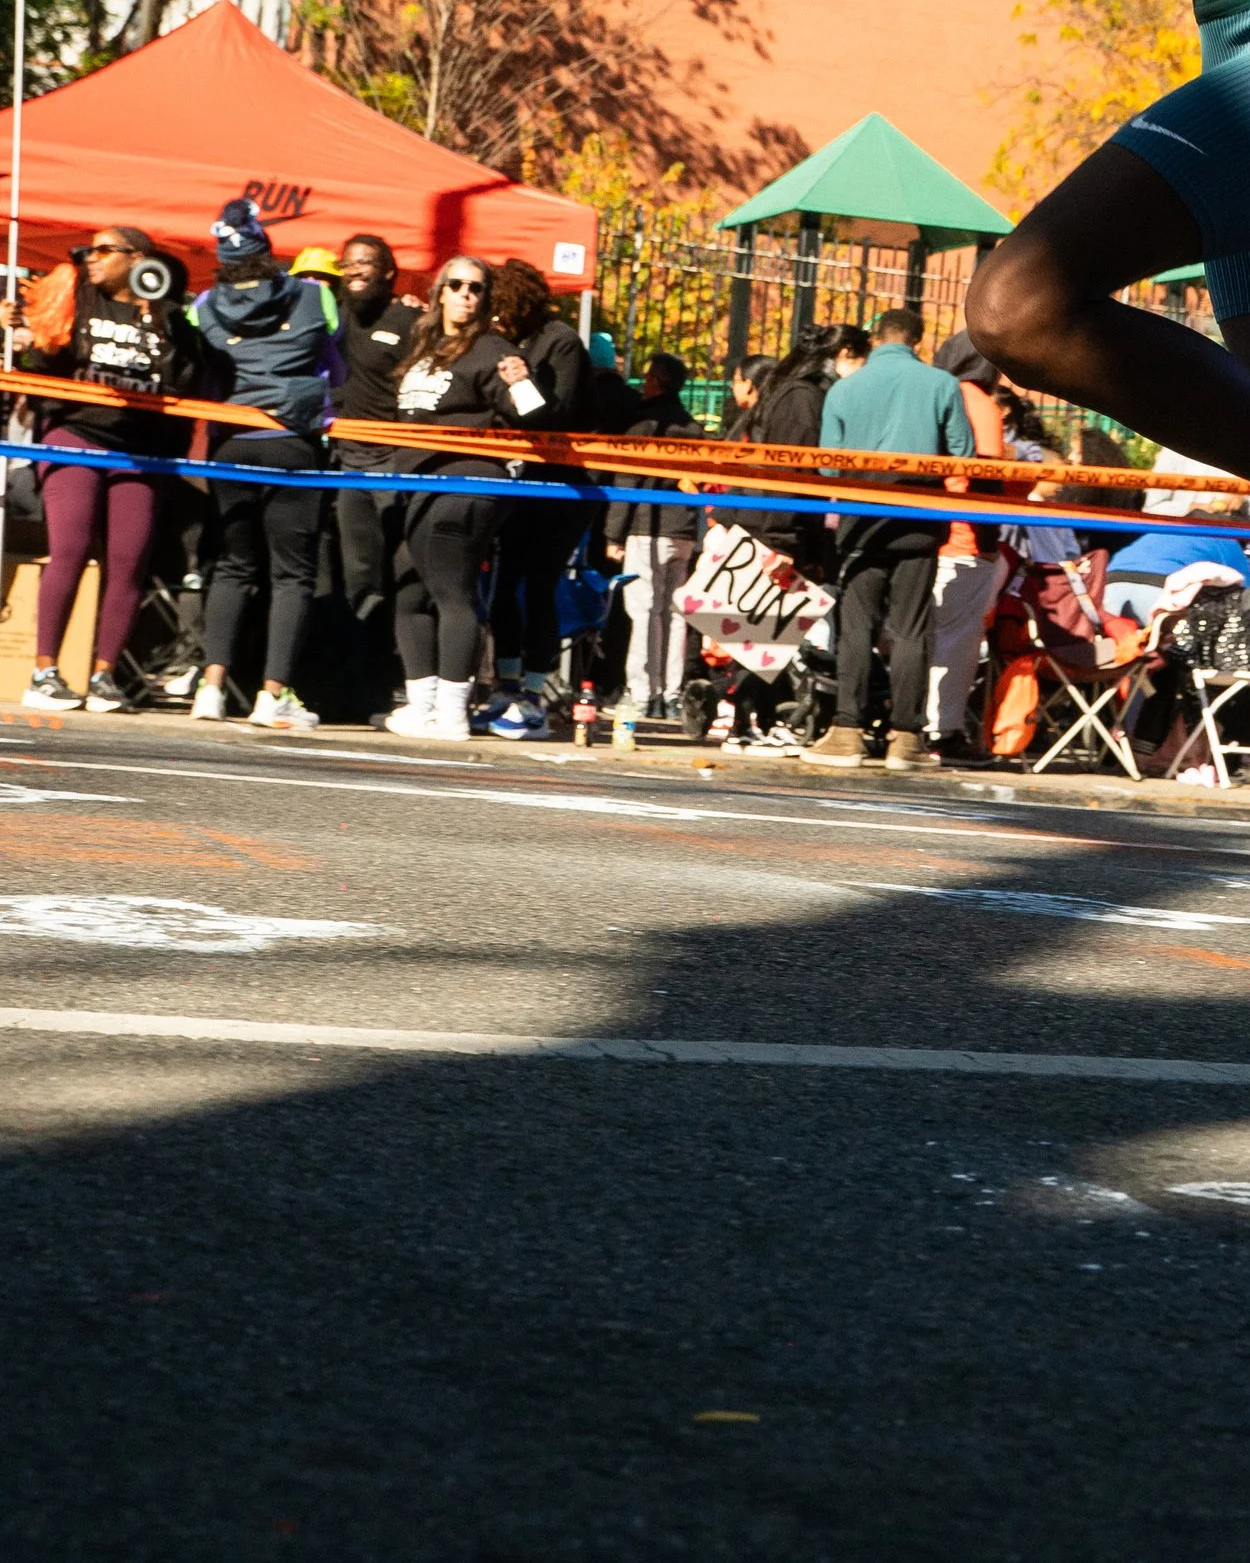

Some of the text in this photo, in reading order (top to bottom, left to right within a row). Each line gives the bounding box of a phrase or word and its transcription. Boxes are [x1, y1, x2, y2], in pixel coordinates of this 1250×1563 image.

[606, 439, 648, 453] NEW
[654, 441, 702, 457] YORK
[763, 449, 805, 464] NEW
[810, 452, 857, 469] YORK
[916, 460, 957, 475] NEW
[961, 463, 1006, 479] YORK
[1063, 470, 1102, 484] NEW
[703, 536, 812, 641] RUN
